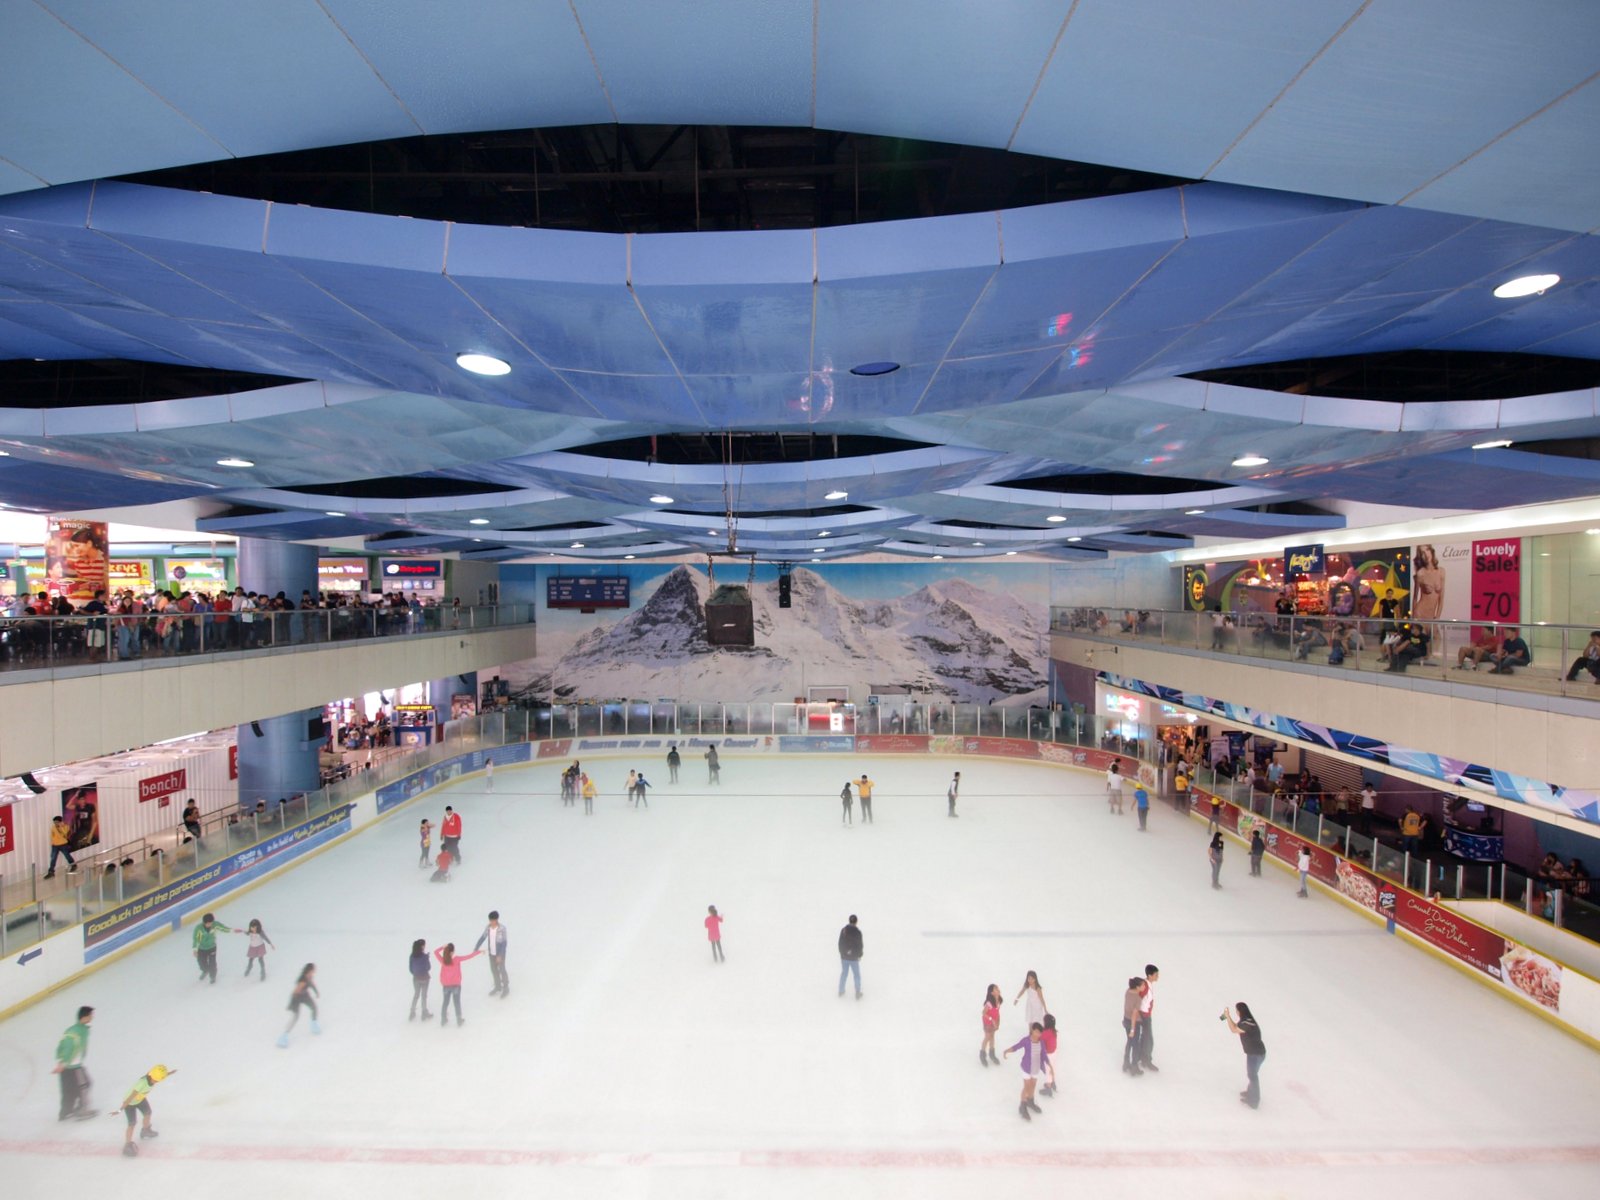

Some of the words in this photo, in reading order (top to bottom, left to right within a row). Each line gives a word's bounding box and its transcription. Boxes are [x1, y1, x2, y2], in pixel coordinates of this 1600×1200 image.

[1442, 546, 1470, 558] Etam
[1475, 543, 1516, 557] Lovely
[1475, 556, 1520, 572] Sale!
[87, 908, 132, 936] Goodluck
[132, 904, 142, 916] to
[143, 897, 154, 911] all
[154, 891, 168, 905] the
[168, 870, 213, 900] participants
[213, 864, 221, 877] of
[1407, 898, 1431, 916] Casual
[1431, 909, 1458, 932] Dining
[1424, 918, 1446, 933] Great
